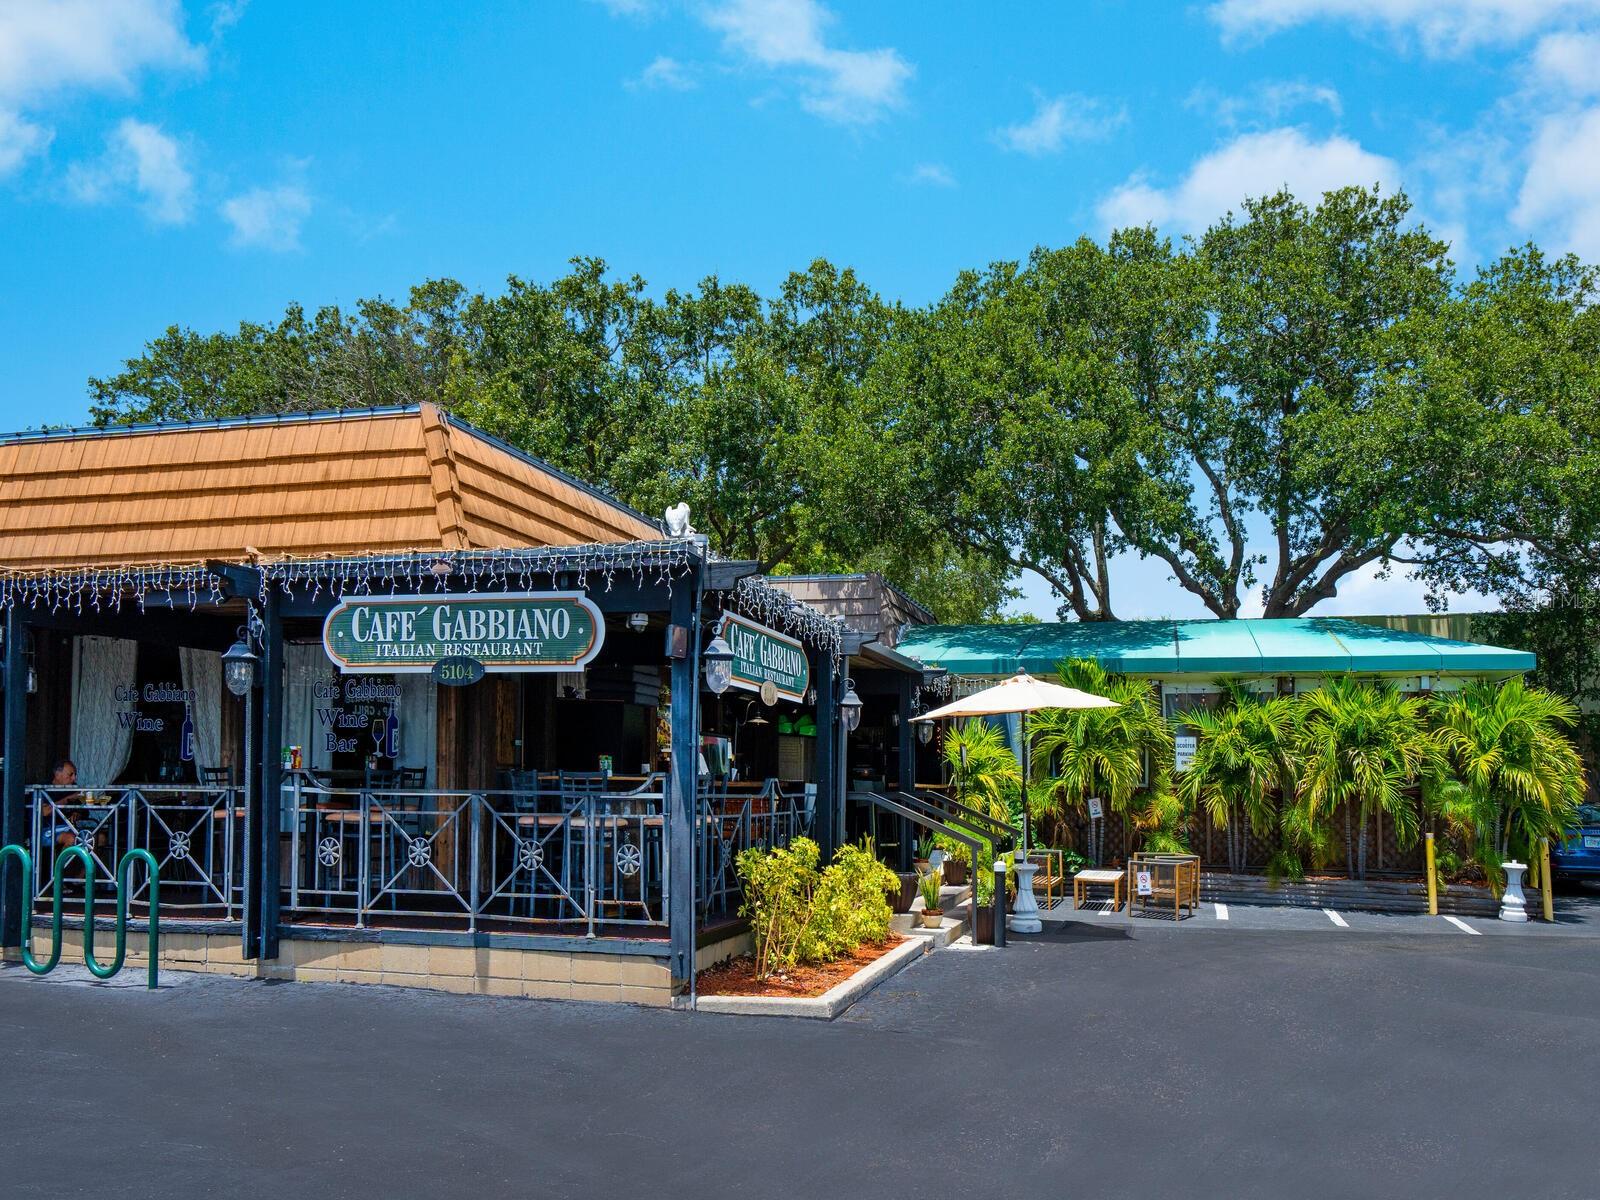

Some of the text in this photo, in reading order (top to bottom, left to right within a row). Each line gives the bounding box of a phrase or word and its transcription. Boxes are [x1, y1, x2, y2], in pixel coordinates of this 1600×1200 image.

[432, 605, 571, 642] GABBIANO
[376, 642, 543, 657] ITALIAN RESTAURANT
[761, 635, 801, 676] GABBIANO
[440, 664, 475, 680] 5104
[740, 660, 795, 688] ITALIAN RESTAURANT
[114, 682, 196, 702] Cafe Gabbiano
[313, 677, 402, 700] Cafe Gabbiano
[116, 711, 164, 732] Wine
[315, 707, 369, 728] Wine
[324, 732, 358, 752] Bar
